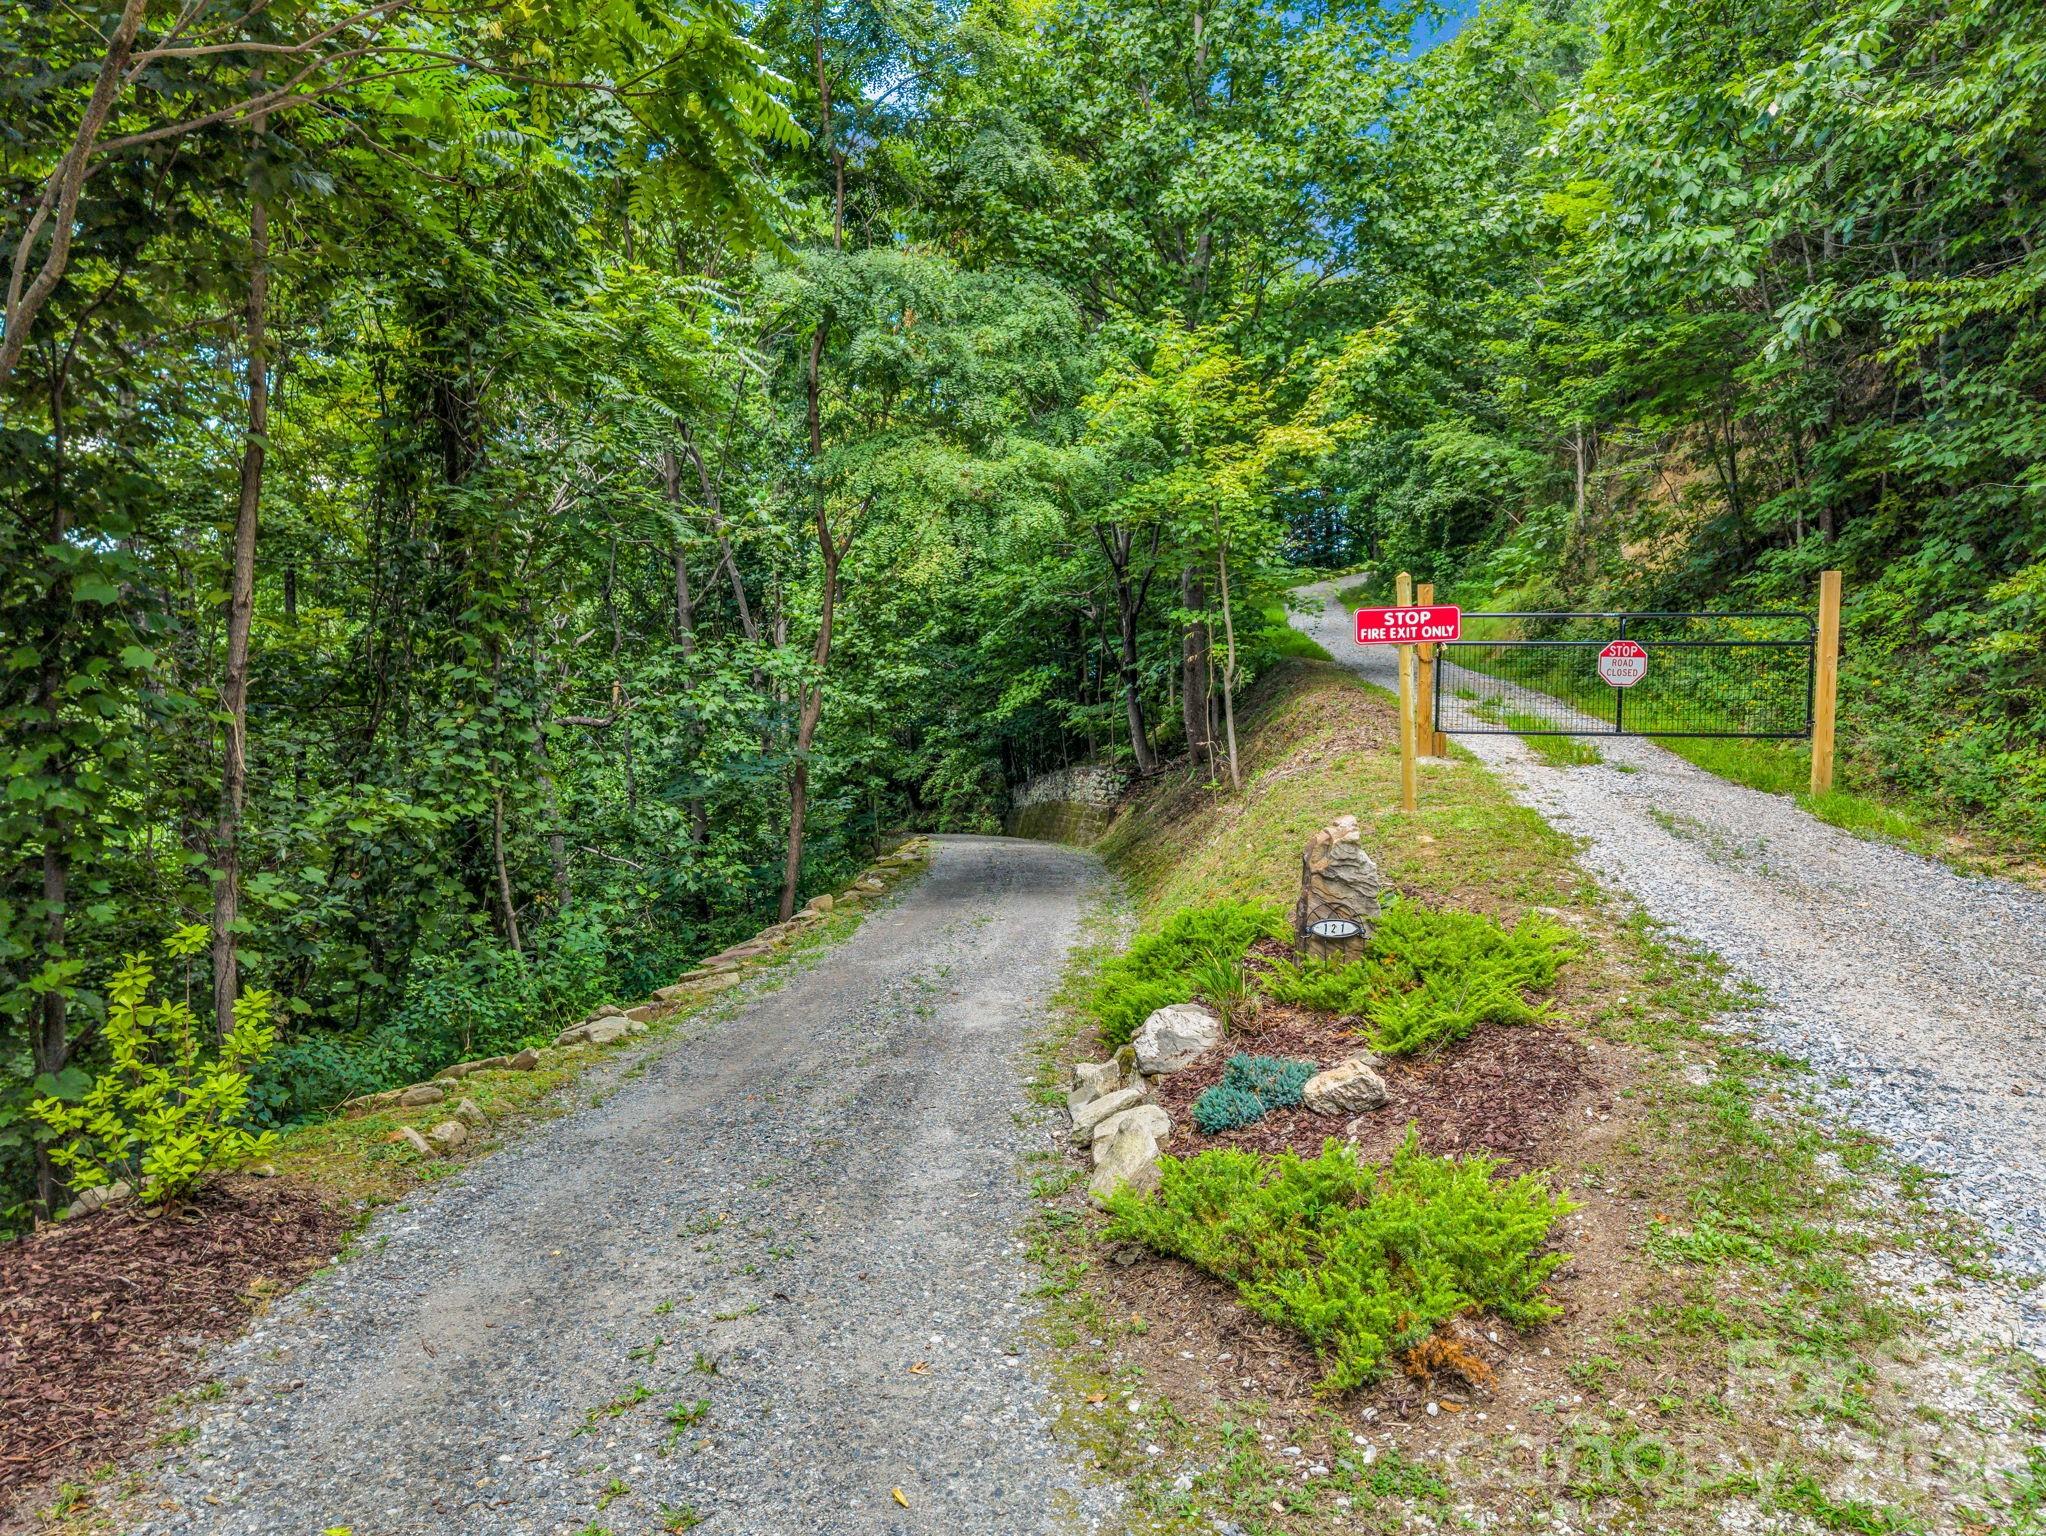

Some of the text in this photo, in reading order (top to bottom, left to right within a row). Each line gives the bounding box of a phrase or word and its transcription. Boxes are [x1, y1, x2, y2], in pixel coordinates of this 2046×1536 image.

[1384, 611, 1431, 626] STOP
[1360, 625, 1455, 640] FIRE EXIT ONLY
[1609, 645, 1638, 657] STOP
[1612, 659, 1634, 667] ROAD
[1606, 668, 1638, 677] CLOSED
[1324, 923, 1345, 935] 121
